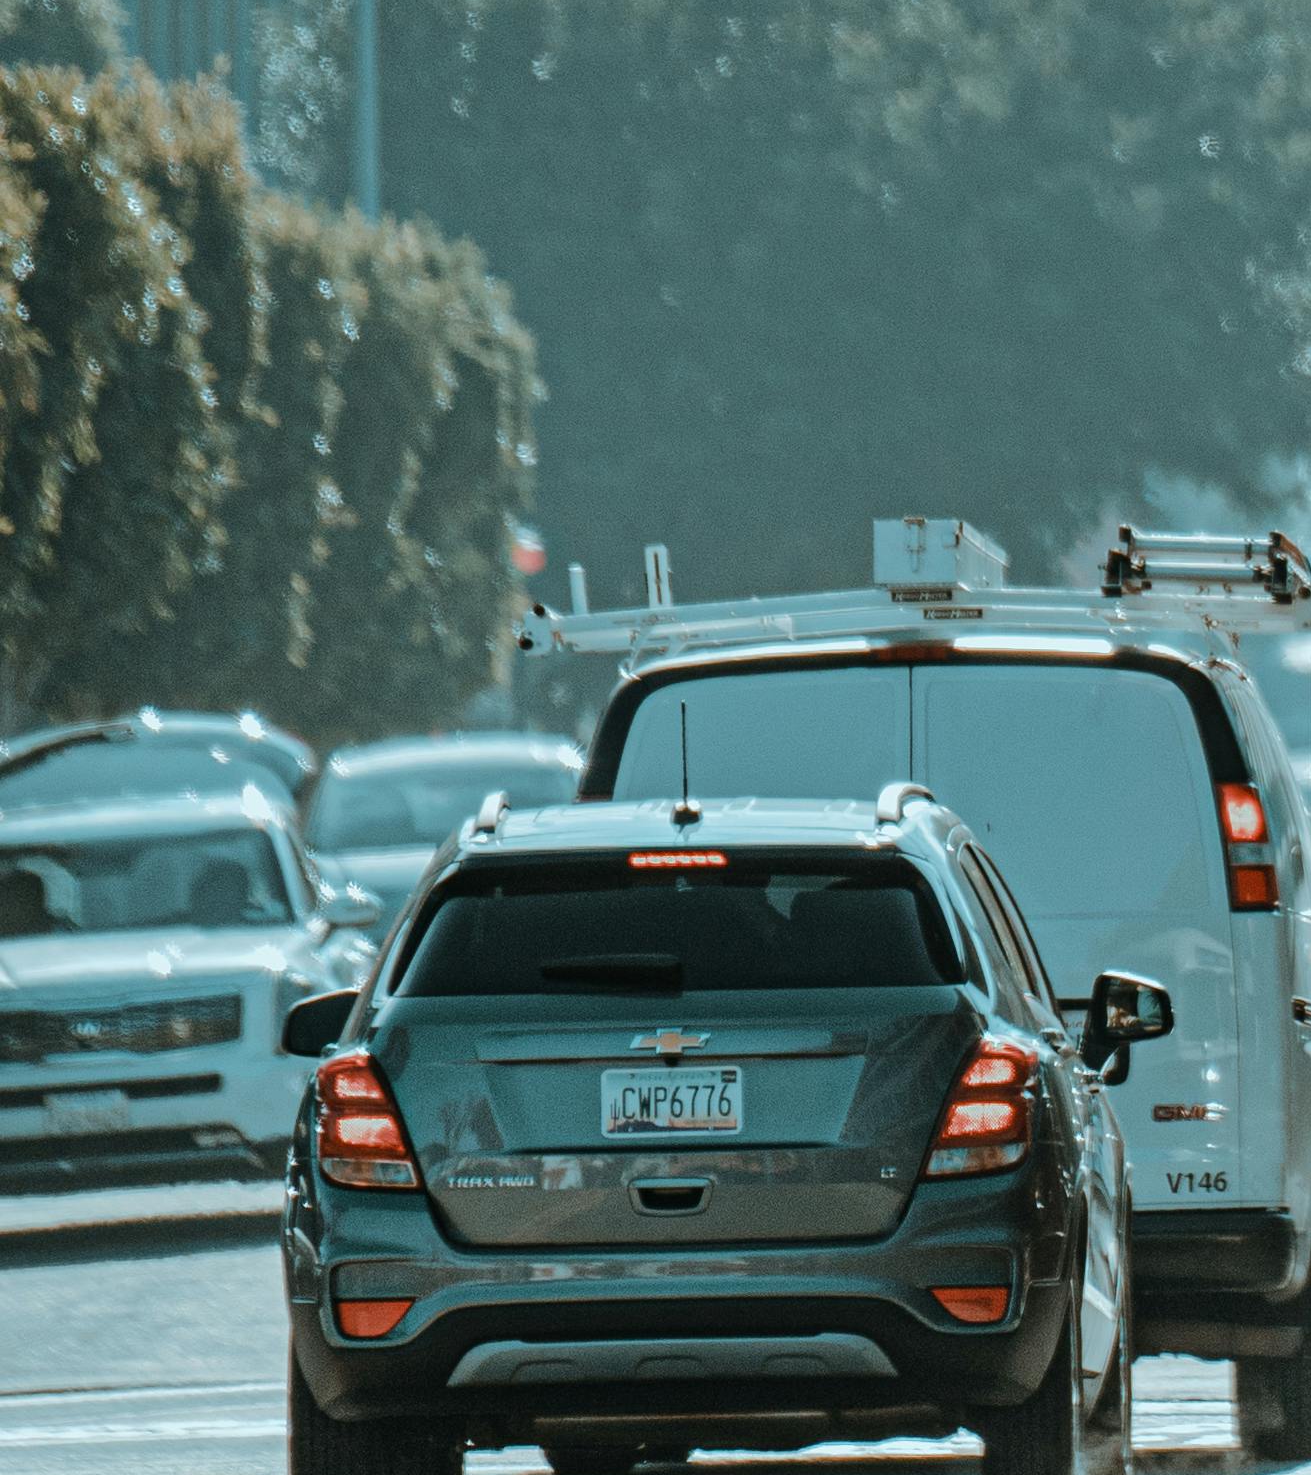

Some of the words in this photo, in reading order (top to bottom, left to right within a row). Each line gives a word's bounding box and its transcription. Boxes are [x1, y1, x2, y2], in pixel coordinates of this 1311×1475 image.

[622, 1084, 731, 1119] CWP6776
[447, 1175, 495, 1189] TRAX
[499, 1175, 534, 1187] AWD
[1166, 1171, 1228, 1194] V146
